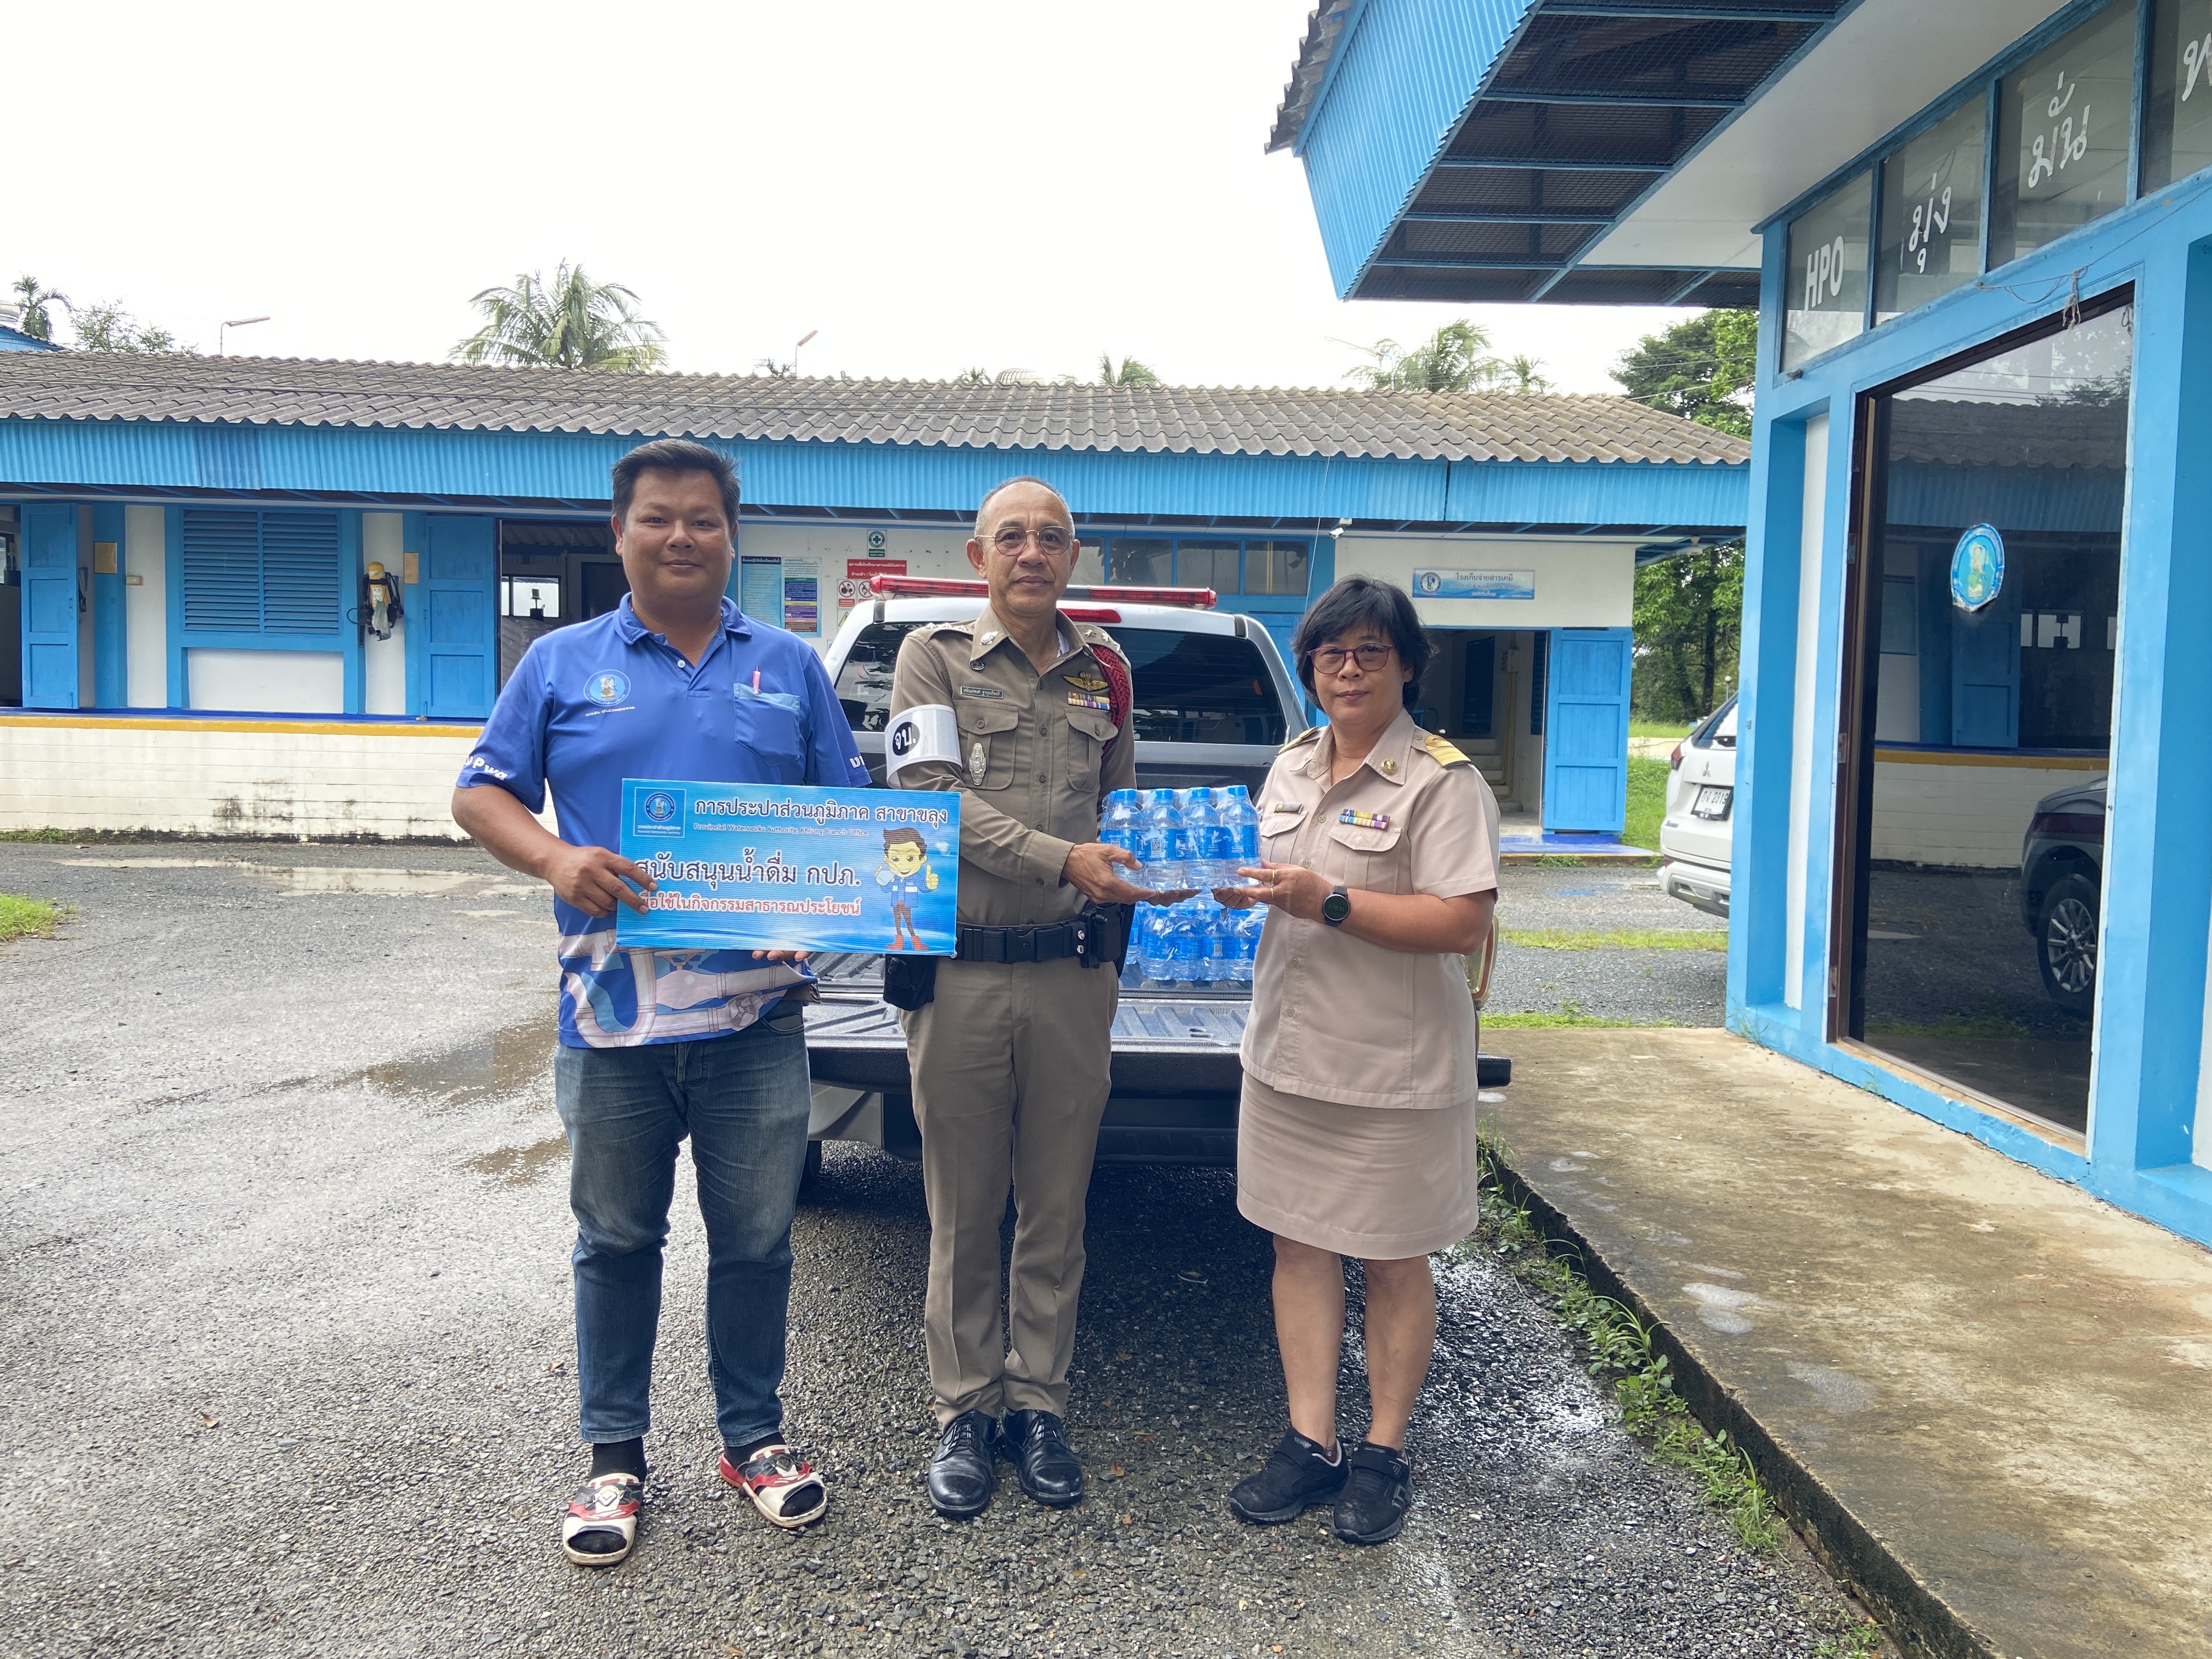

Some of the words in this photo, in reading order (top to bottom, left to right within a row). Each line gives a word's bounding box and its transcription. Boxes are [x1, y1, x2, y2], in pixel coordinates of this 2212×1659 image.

[1804, 235, 1844, 312] HPO
[1909, 172, 1952, 274] มุ่ง
[2028, 71, 2091, 189] มั่น
[1455, 572, 1513, 582] โรงเก็บจ่ายสารเคมี
[695, 798, 869, 825] การประปาส่วนภูมิภาค
[876, 806, 948, 828] สาขาขลุง
[636, 848, 797, 889] สนับสนุนน้ำดื่ม
[807, 861, 861, 885] กปภ.
